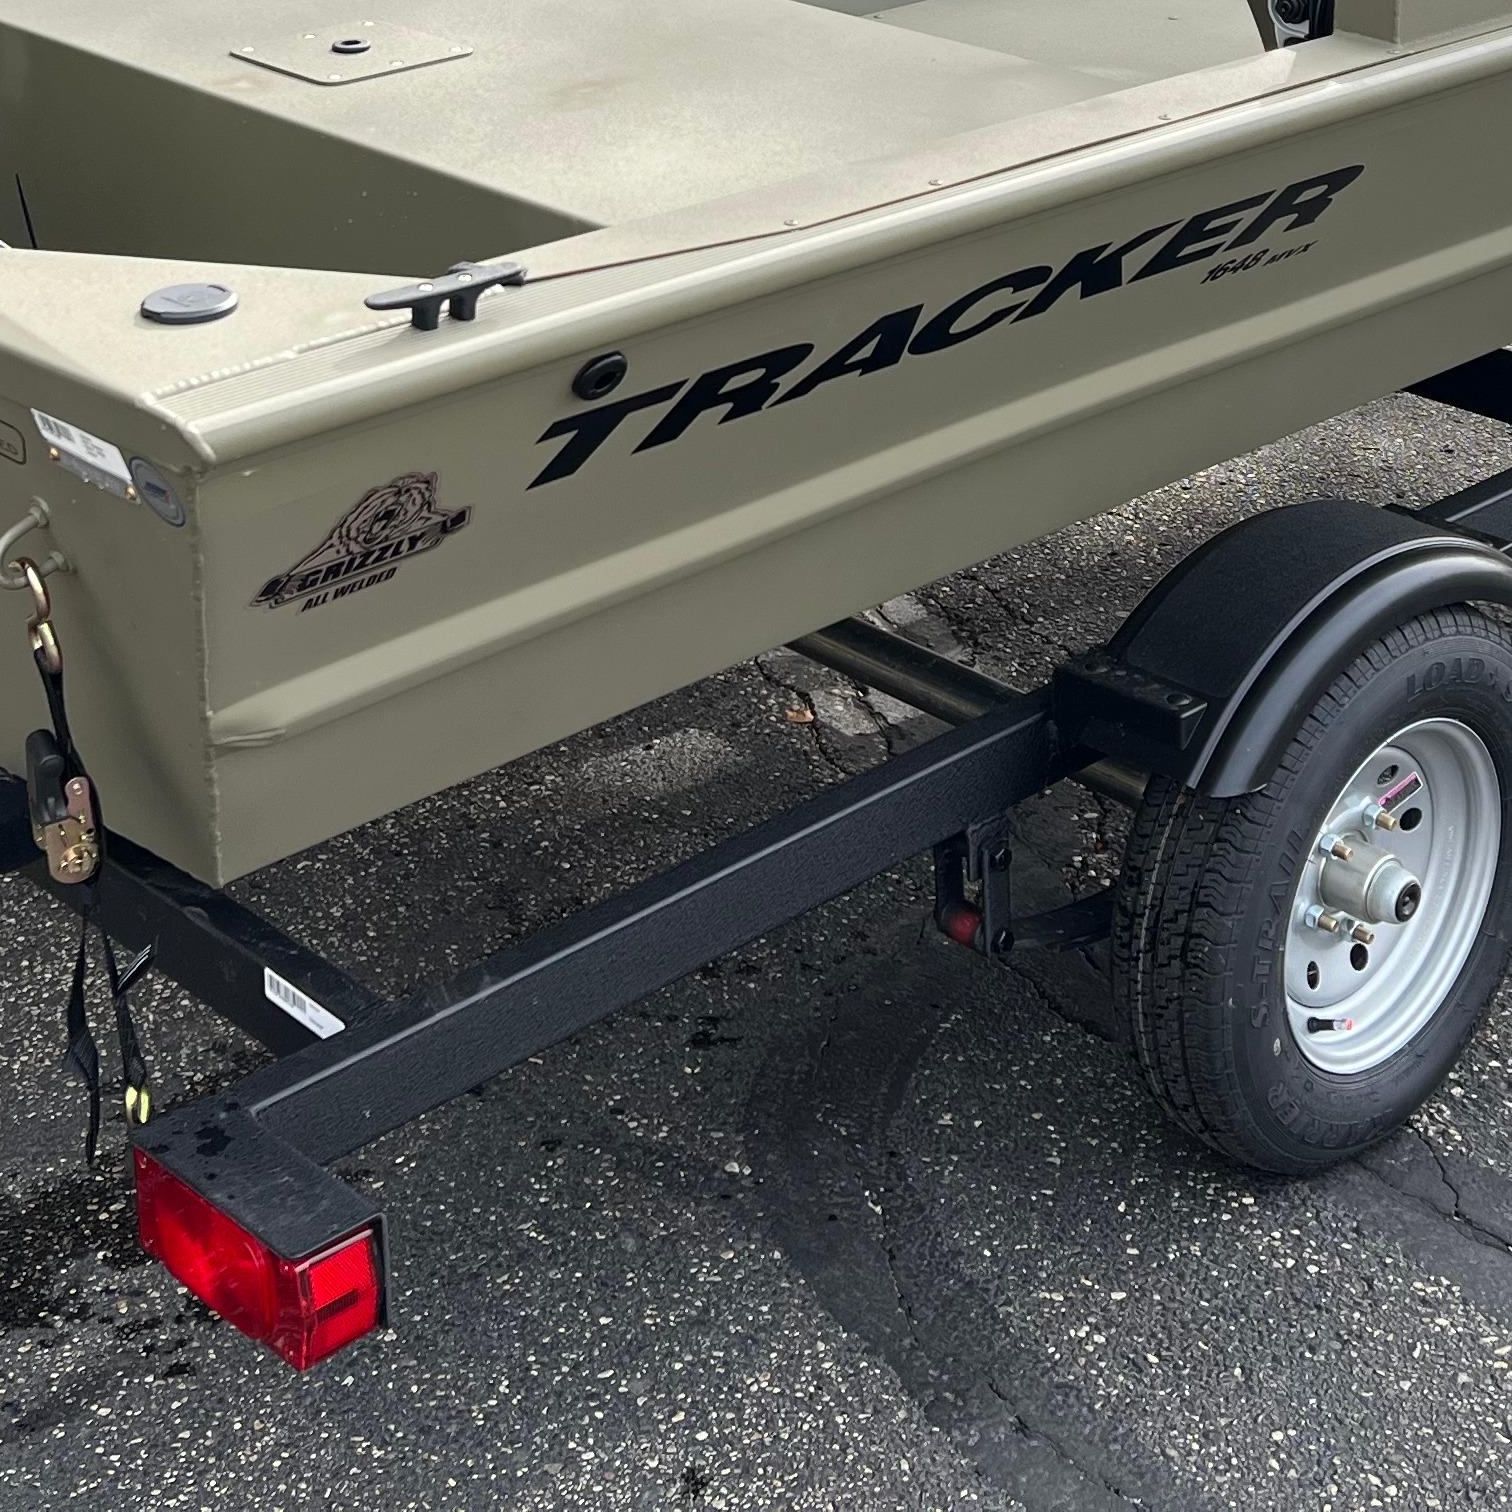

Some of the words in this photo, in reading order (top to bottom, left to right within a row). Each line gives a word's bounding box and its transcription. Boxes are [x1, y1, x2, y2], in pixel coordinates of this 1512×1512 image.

[1200, 248, 1270, 284] 1648
[527, 164, 1365, 491] TRACKER
[297, 533, 426, 592] GRIZZLY
[300, 594, 330, 613] ALL
[331, 567, 399, 601] WELDED
[1406, 657, 1485, 703] LOAD
